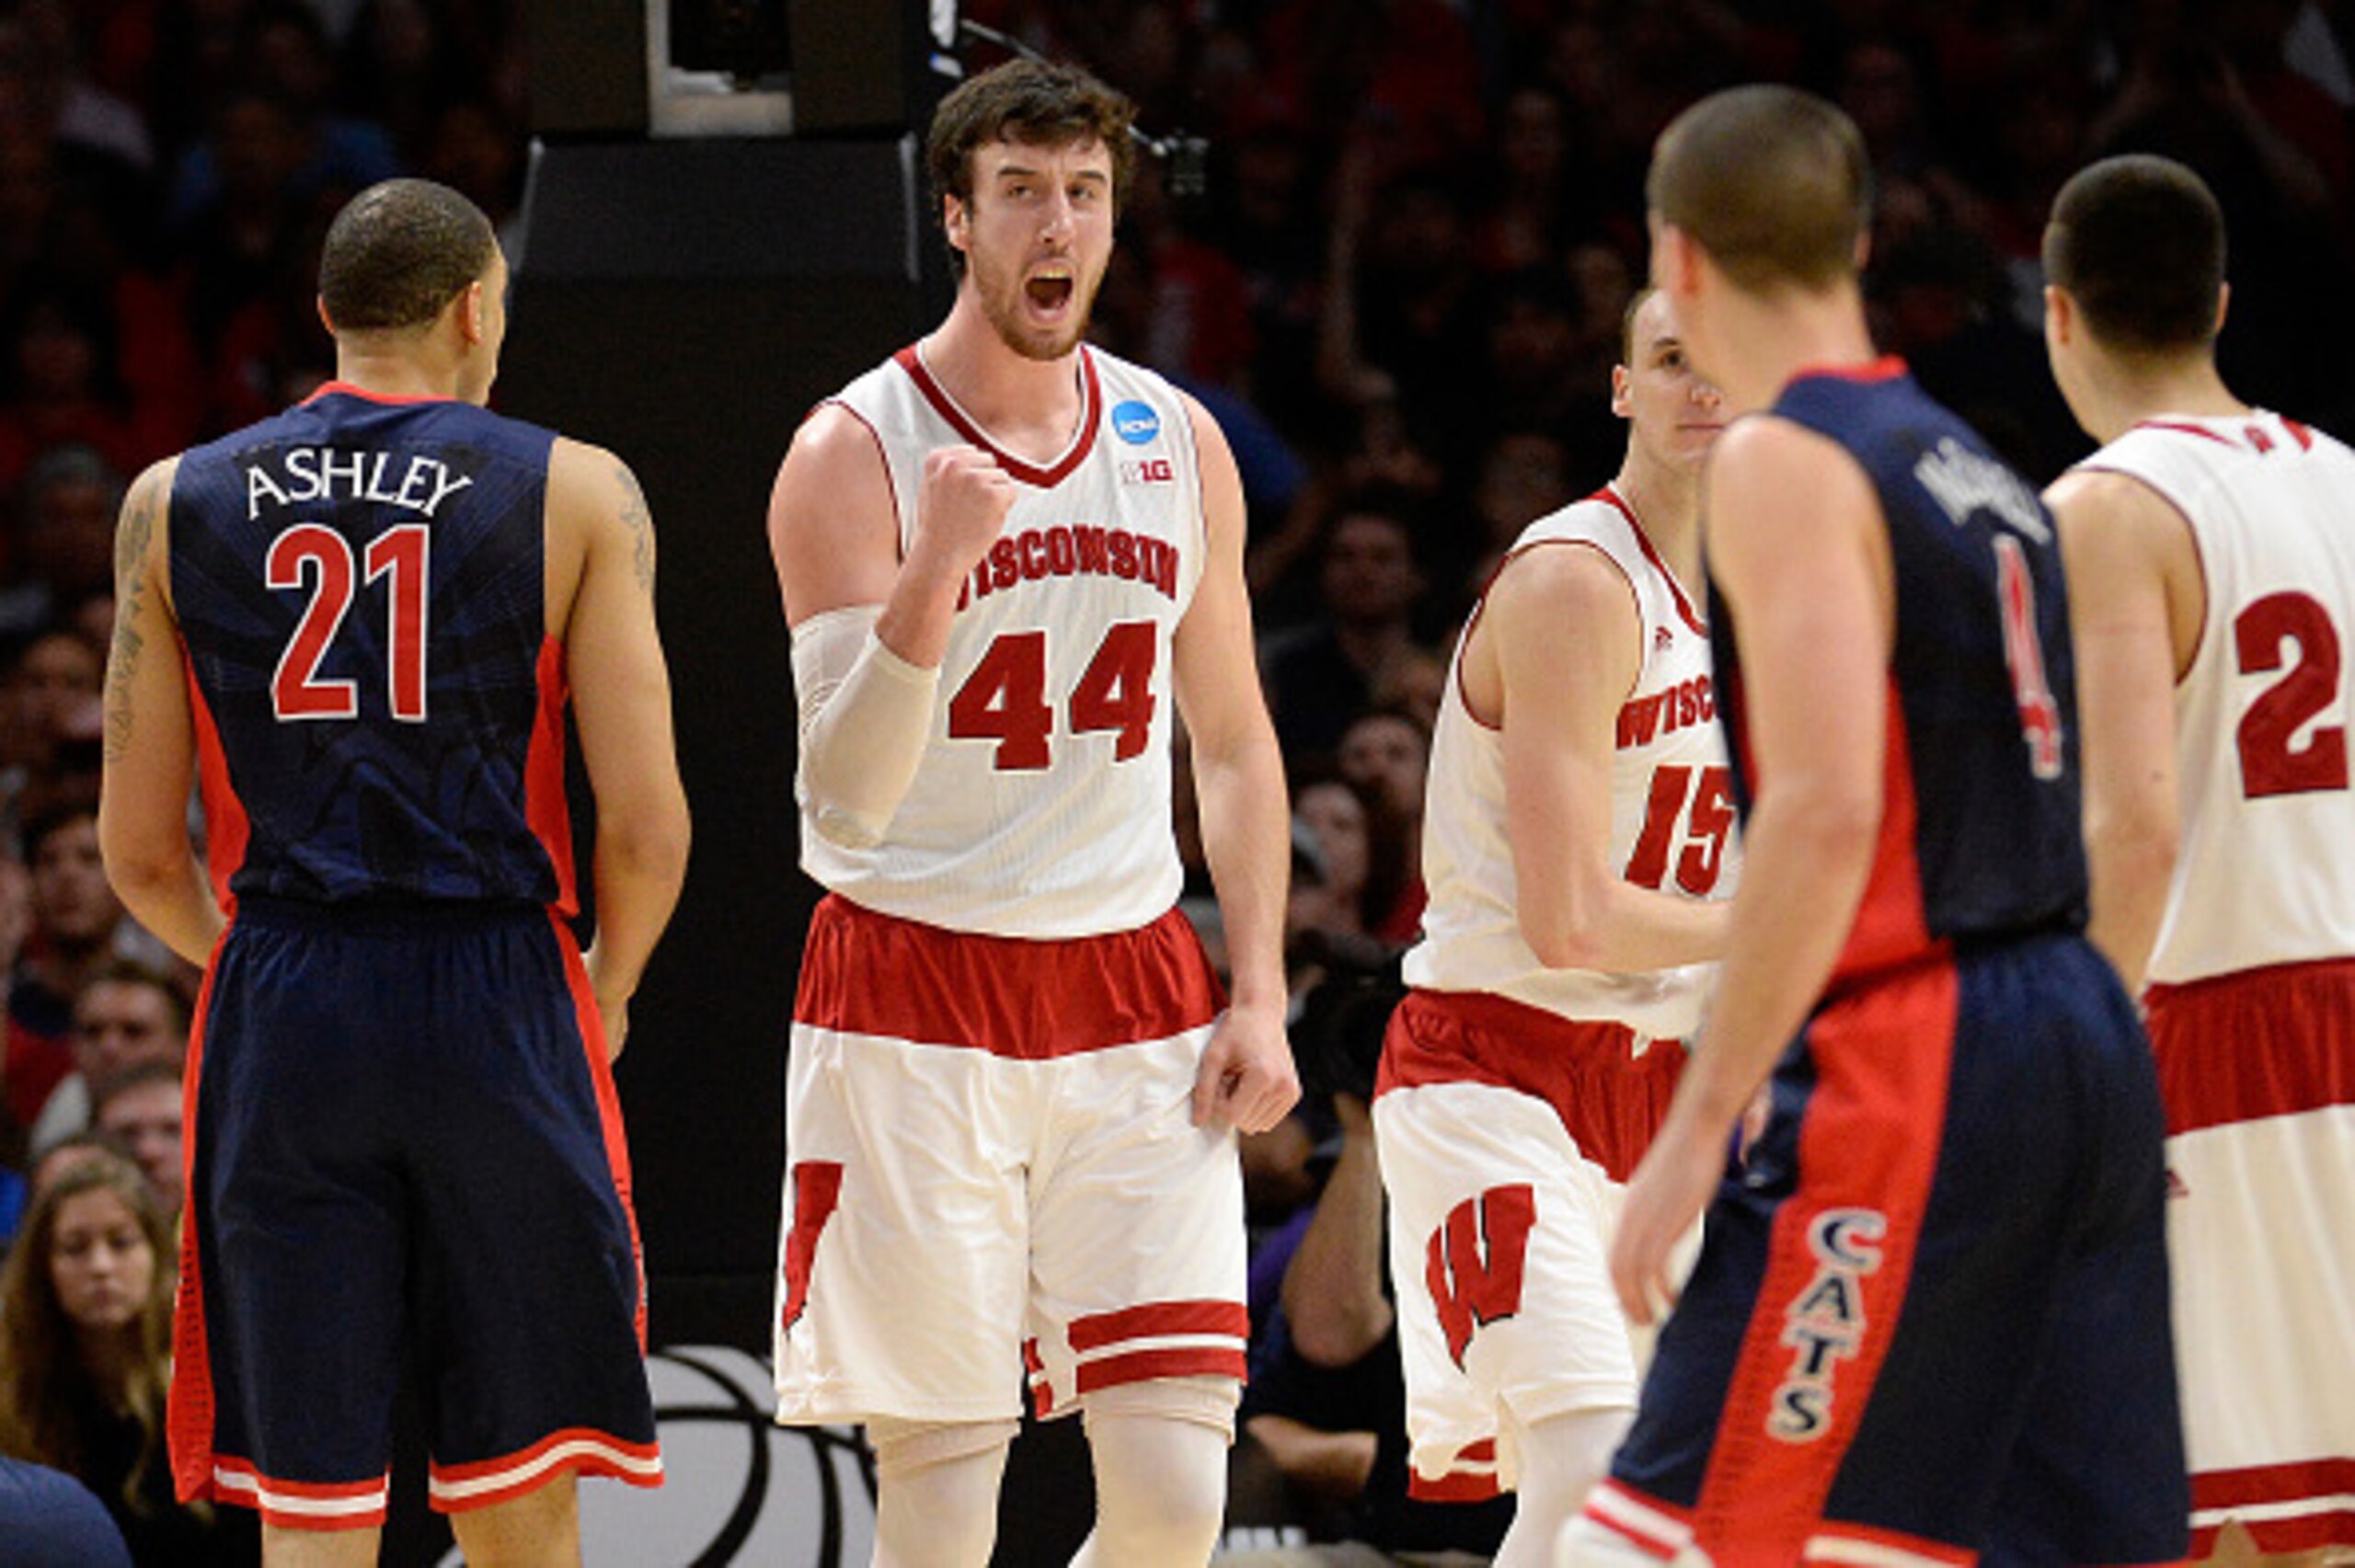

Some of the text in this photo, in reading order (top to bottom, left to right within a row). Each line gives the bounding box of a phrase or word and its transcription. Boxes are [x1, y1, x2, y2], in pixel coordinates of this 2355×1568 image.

[247, 448, 474, 520] ASHLEY
[956, 523, 1180, 612] ISCONSIN
[266, 522, 431, 722] 21
[948, 620, 1158, 771] 44
[1991, 531, 2062, 780] 4
[2234, 589, 2349, 800] 2
[1624, 765, 1737, 895] 15
[1426, 1183, 1537, 1375] W
[1764, 1207, 1887, 1444] CATS
